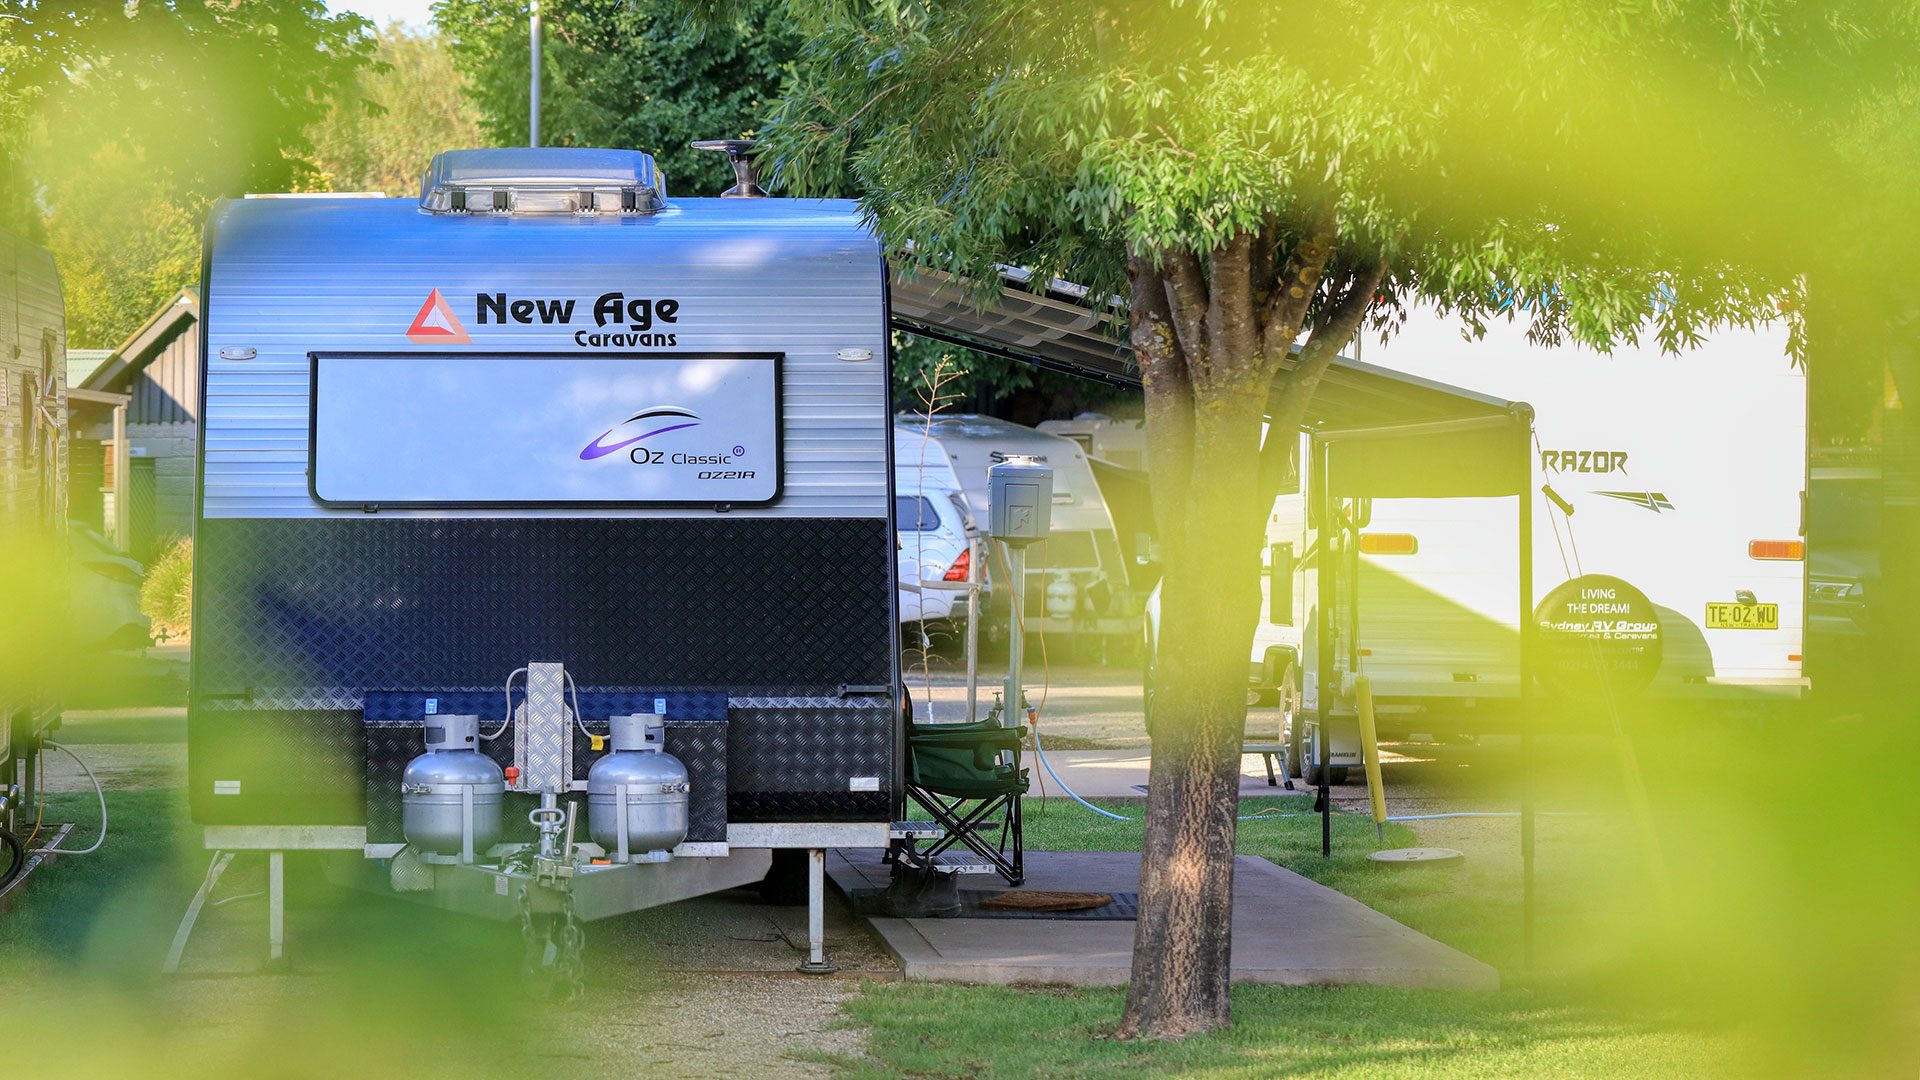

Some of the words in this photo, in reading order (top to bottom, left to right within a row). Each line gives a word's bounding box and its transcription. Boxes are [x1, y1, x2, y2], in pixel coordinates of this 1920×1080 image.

[476, 292, 576, 325] New
[593, 291, 680, 332] Age
[574, 330, 678, 347] Caravans
[630, 447, 665, 465] Oz
[671, 453, 732, 465] Classic
[1541, 450, 1628, 476] RAZOR
[697, 471, 756, 480] OZ21R
[1581, 588, 1616, 600] LIVING
[1567, 603, 1588, 614] THE
[1589, 603, 1630, 614] DREAM!
[1539, 620, 1589, 632] Sydney
[1591, 620, 1614, 632] RV
[1615, 620, 1658, 632] Group
[1613, 632, 1658, 640] Caravans
